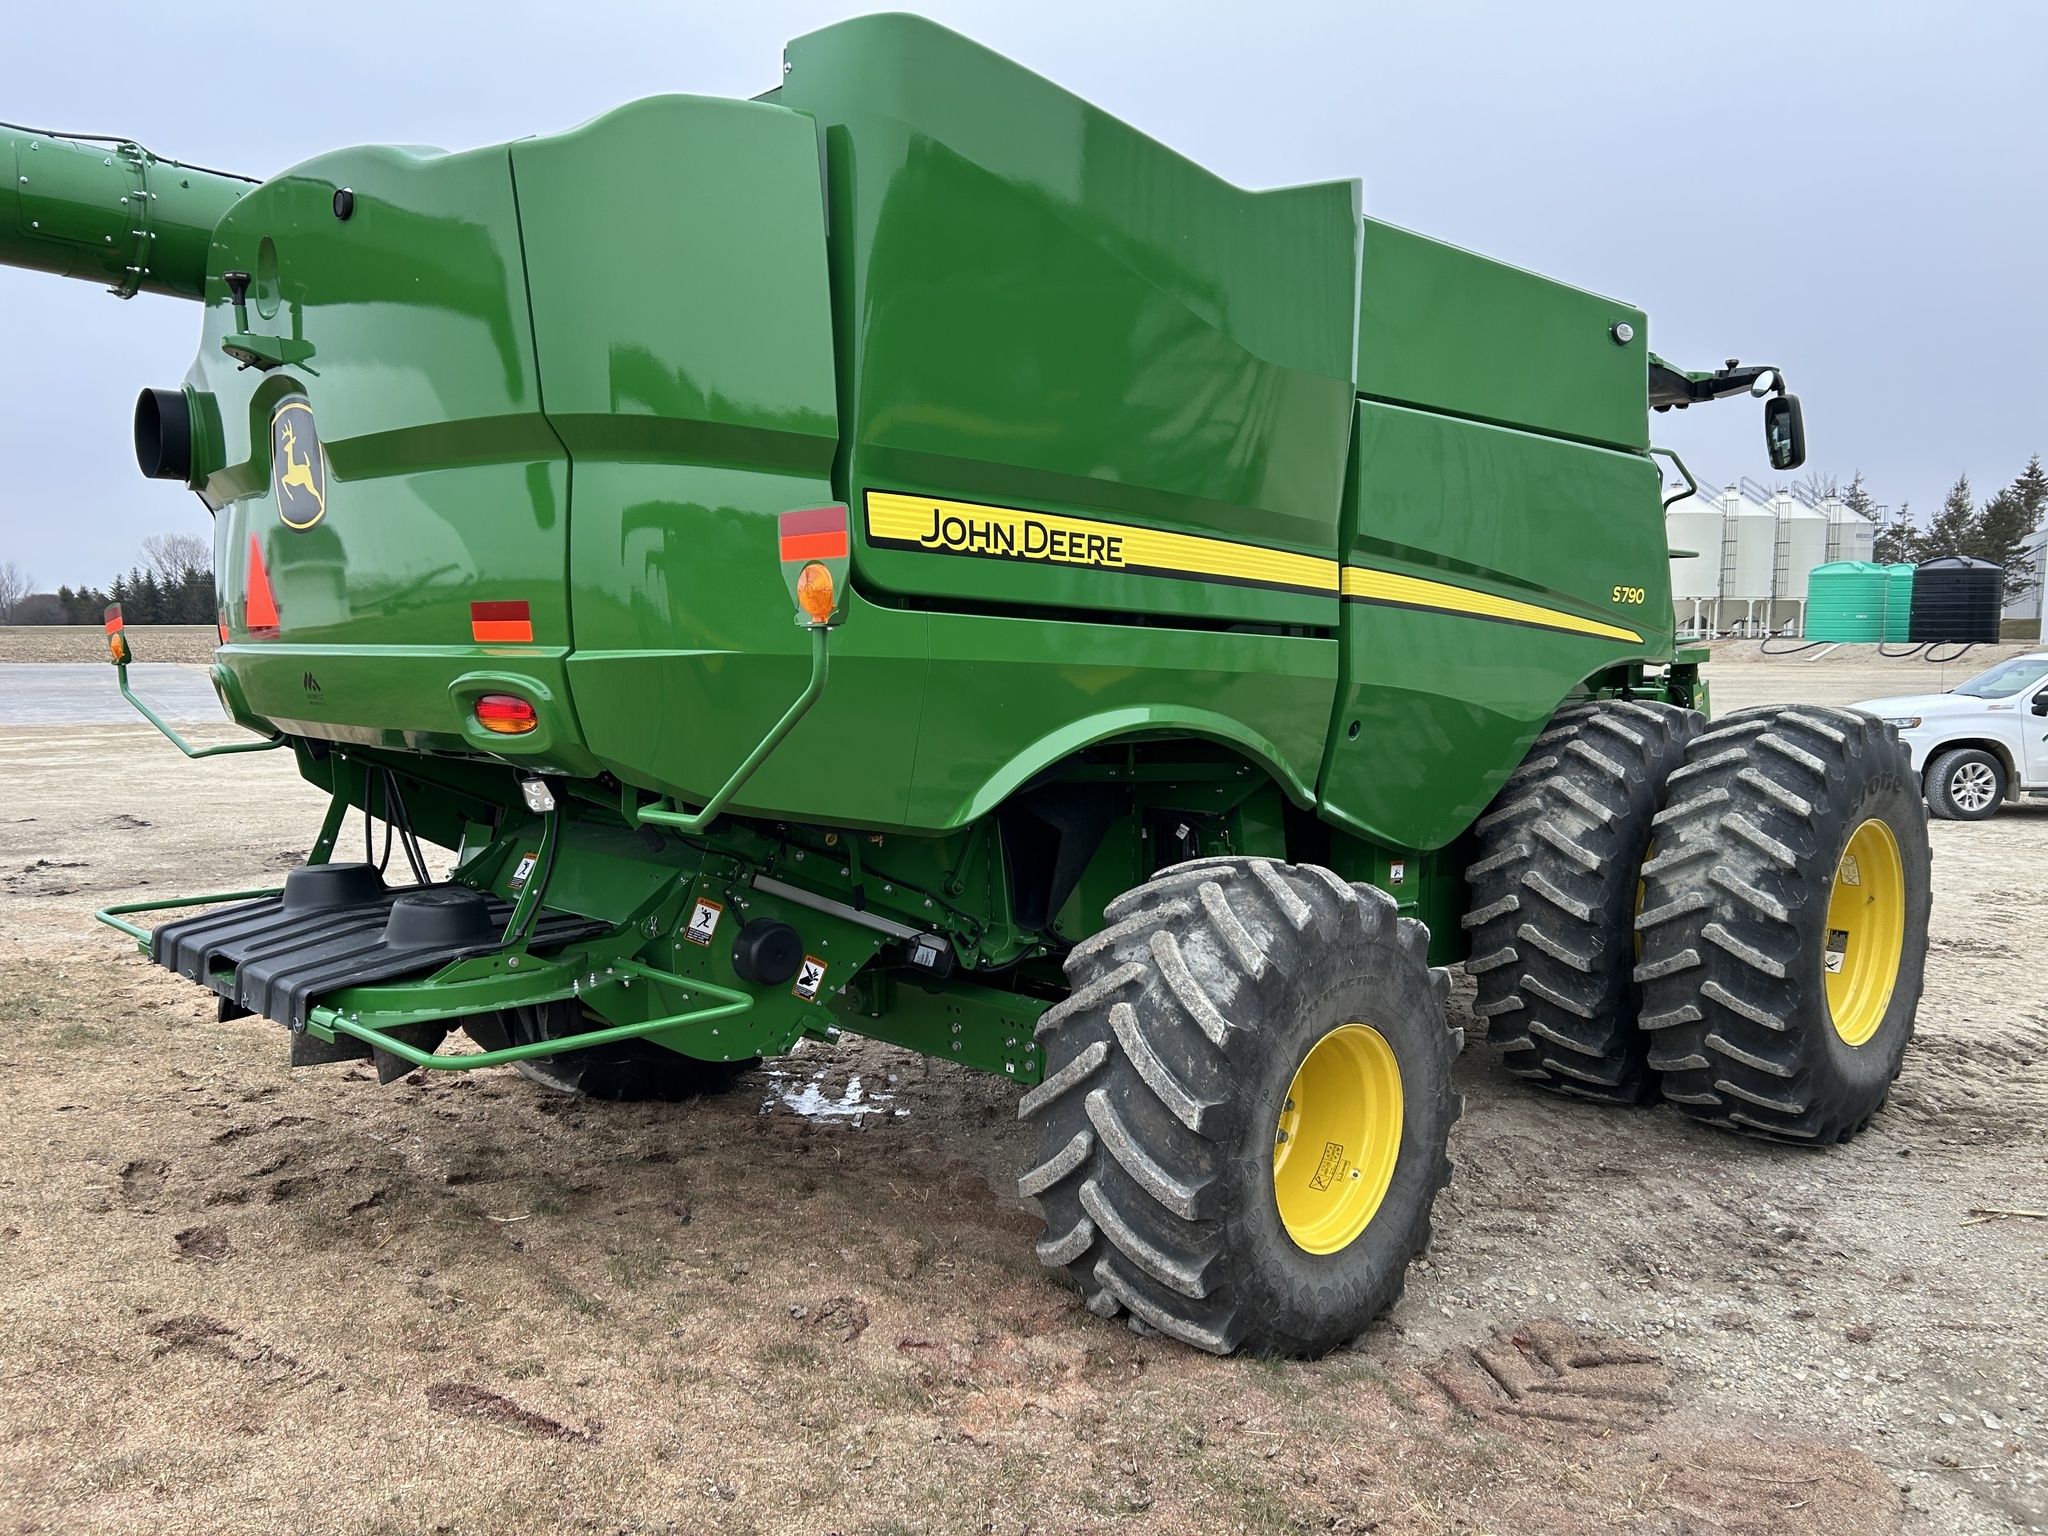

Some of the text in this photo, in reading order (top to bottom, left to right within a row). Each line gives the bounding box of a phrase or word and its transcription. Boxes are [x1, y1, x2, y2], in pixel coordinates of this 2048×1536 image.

[920, 508, 1123, 563] JOHN DEERE
[1612, 585, 1645, 605] S790
